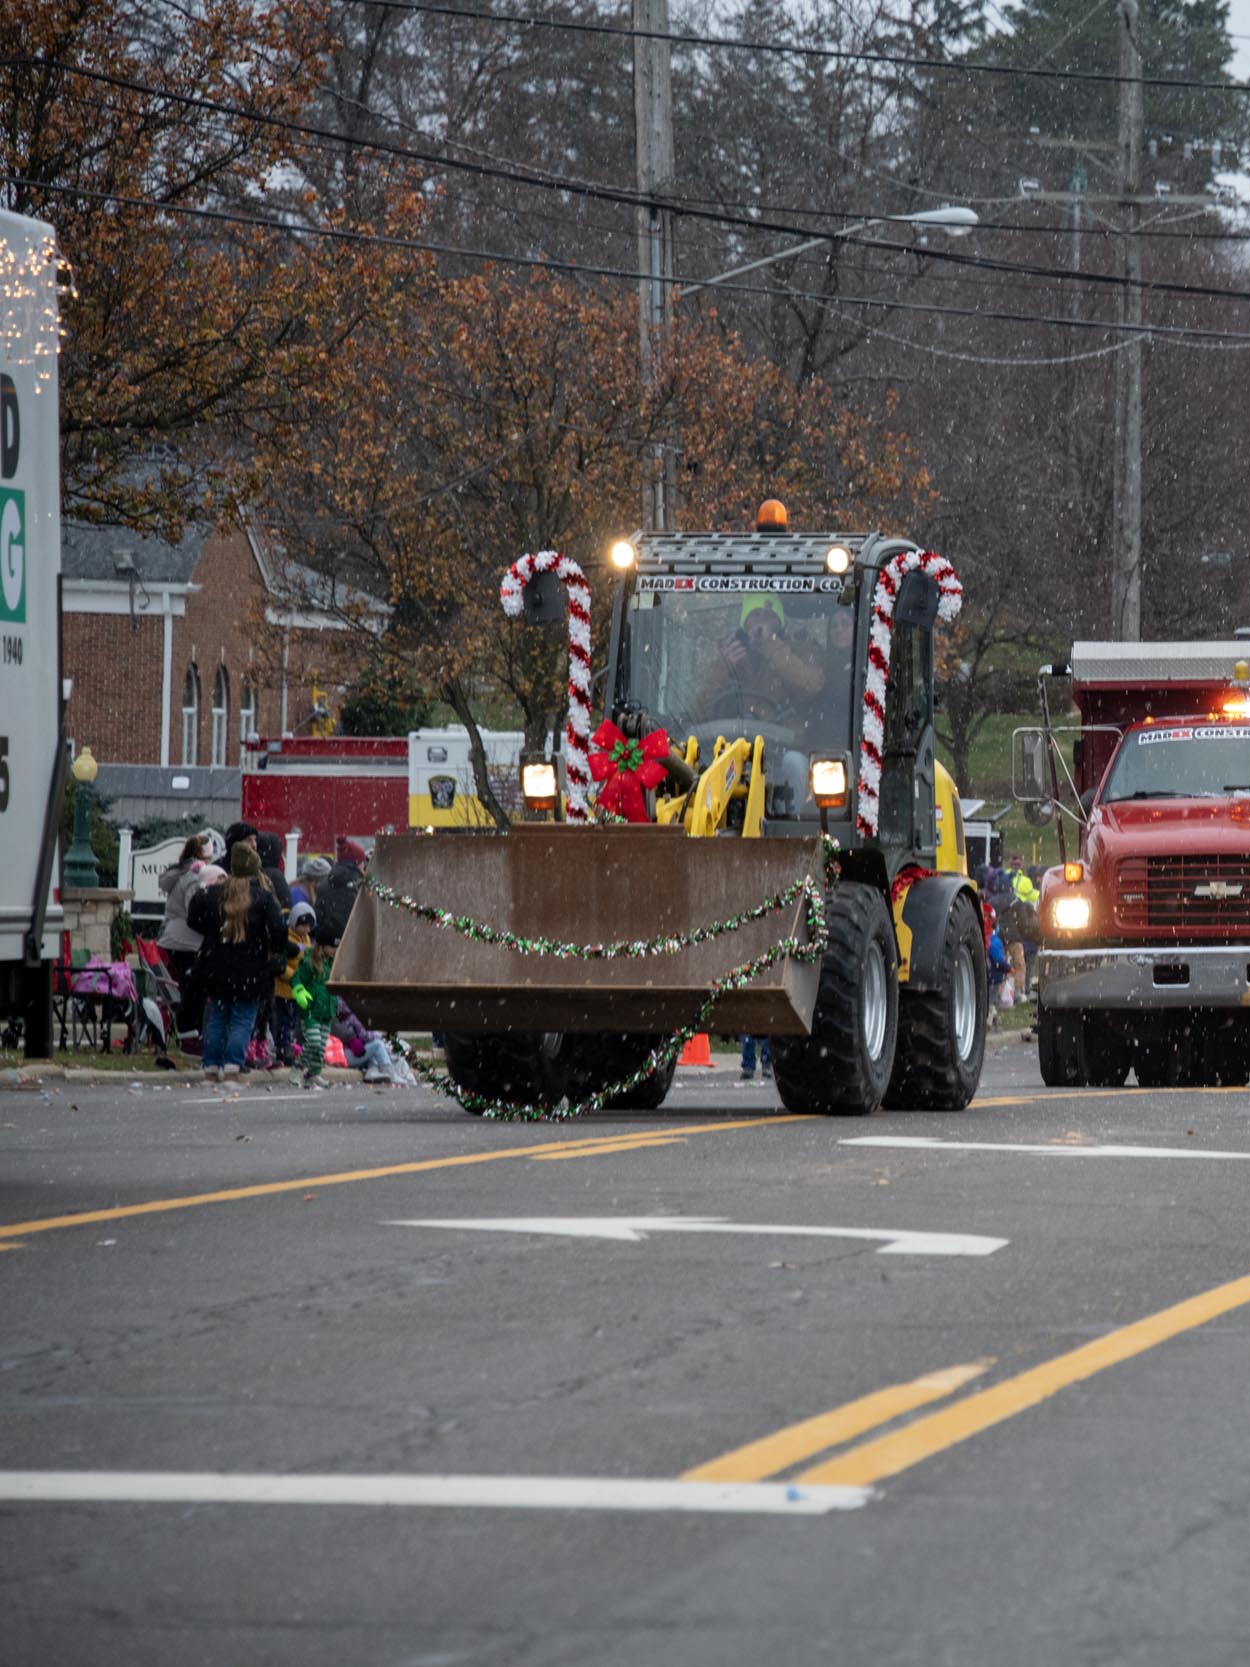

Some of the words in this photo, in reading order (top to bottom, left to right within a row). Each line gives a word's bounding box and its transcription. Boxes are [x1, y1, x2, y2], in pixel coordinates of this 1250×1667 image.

[700, 577, 814, 590] CONSTRUCTION
[821, 579, 845, 591] CO.
[3, 635, 23, 666] 1940
